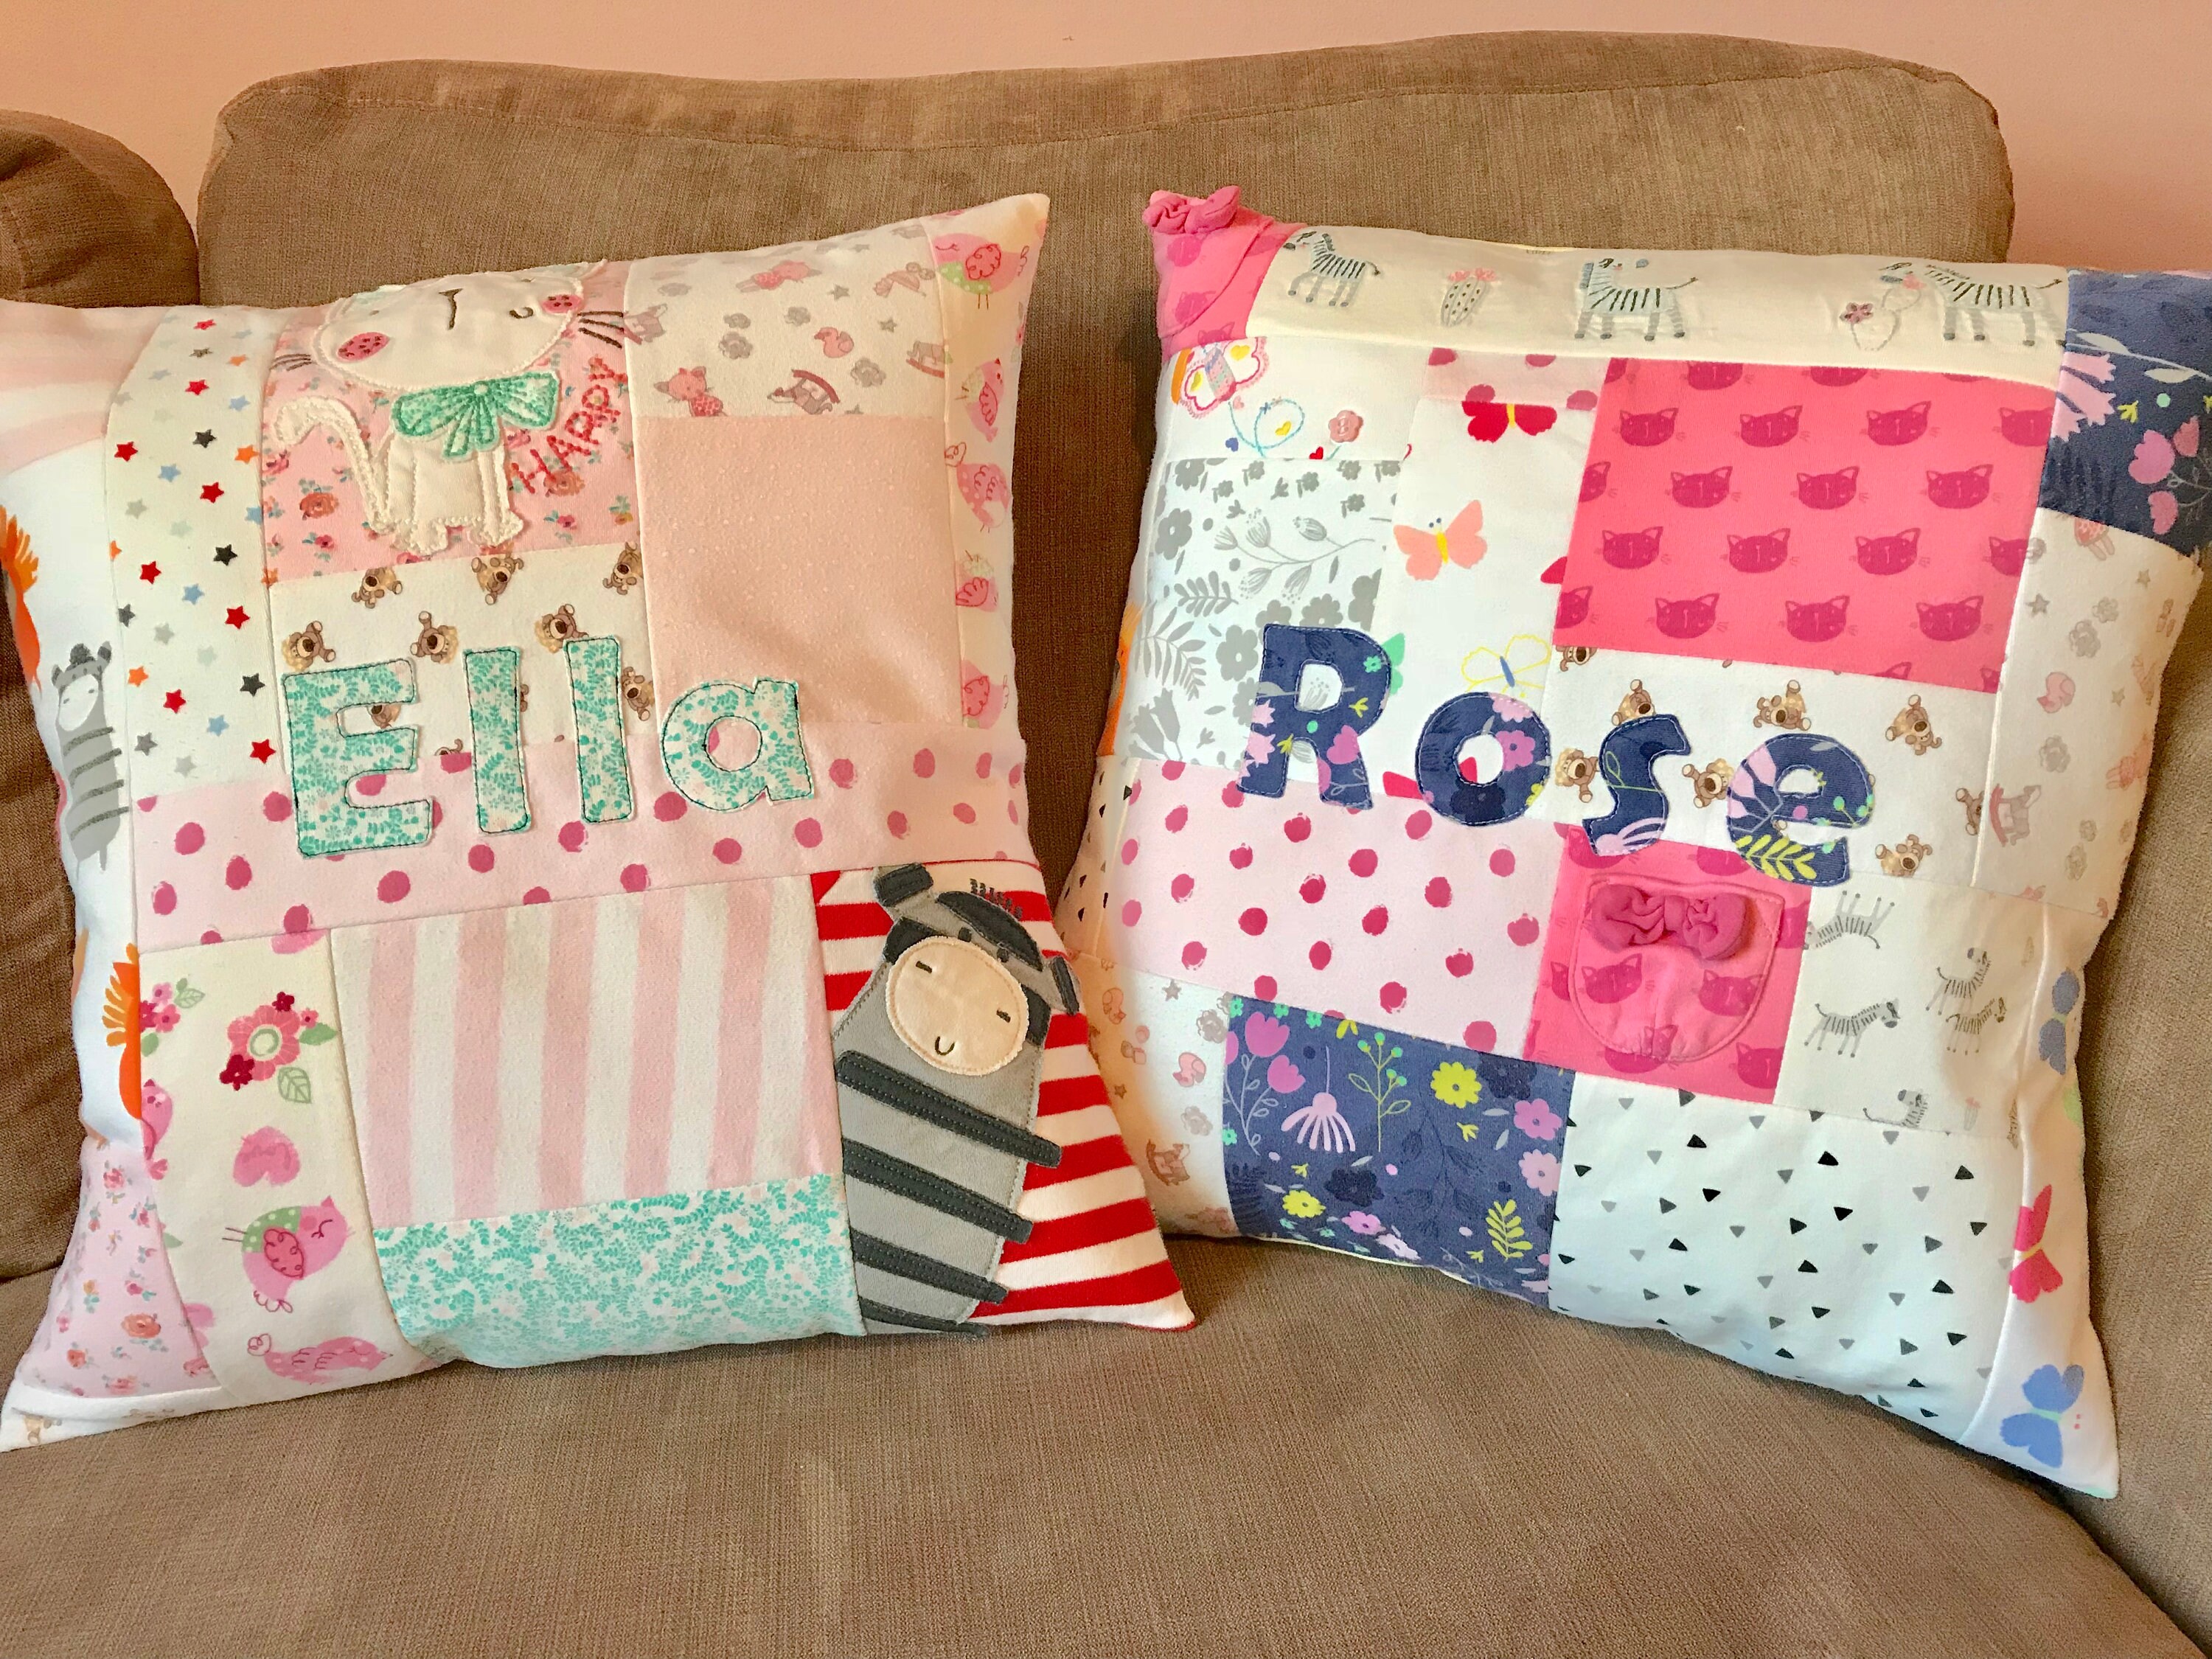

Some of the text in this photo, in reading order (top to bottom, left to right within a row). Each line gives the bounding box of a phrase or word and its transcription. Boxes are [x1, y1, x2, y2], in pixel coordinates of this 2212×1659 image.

[511, 357, 627, 494] HAPPY
[280, 634, 815, 858] Ella
[1237, 623, 1877, 887] Rose
